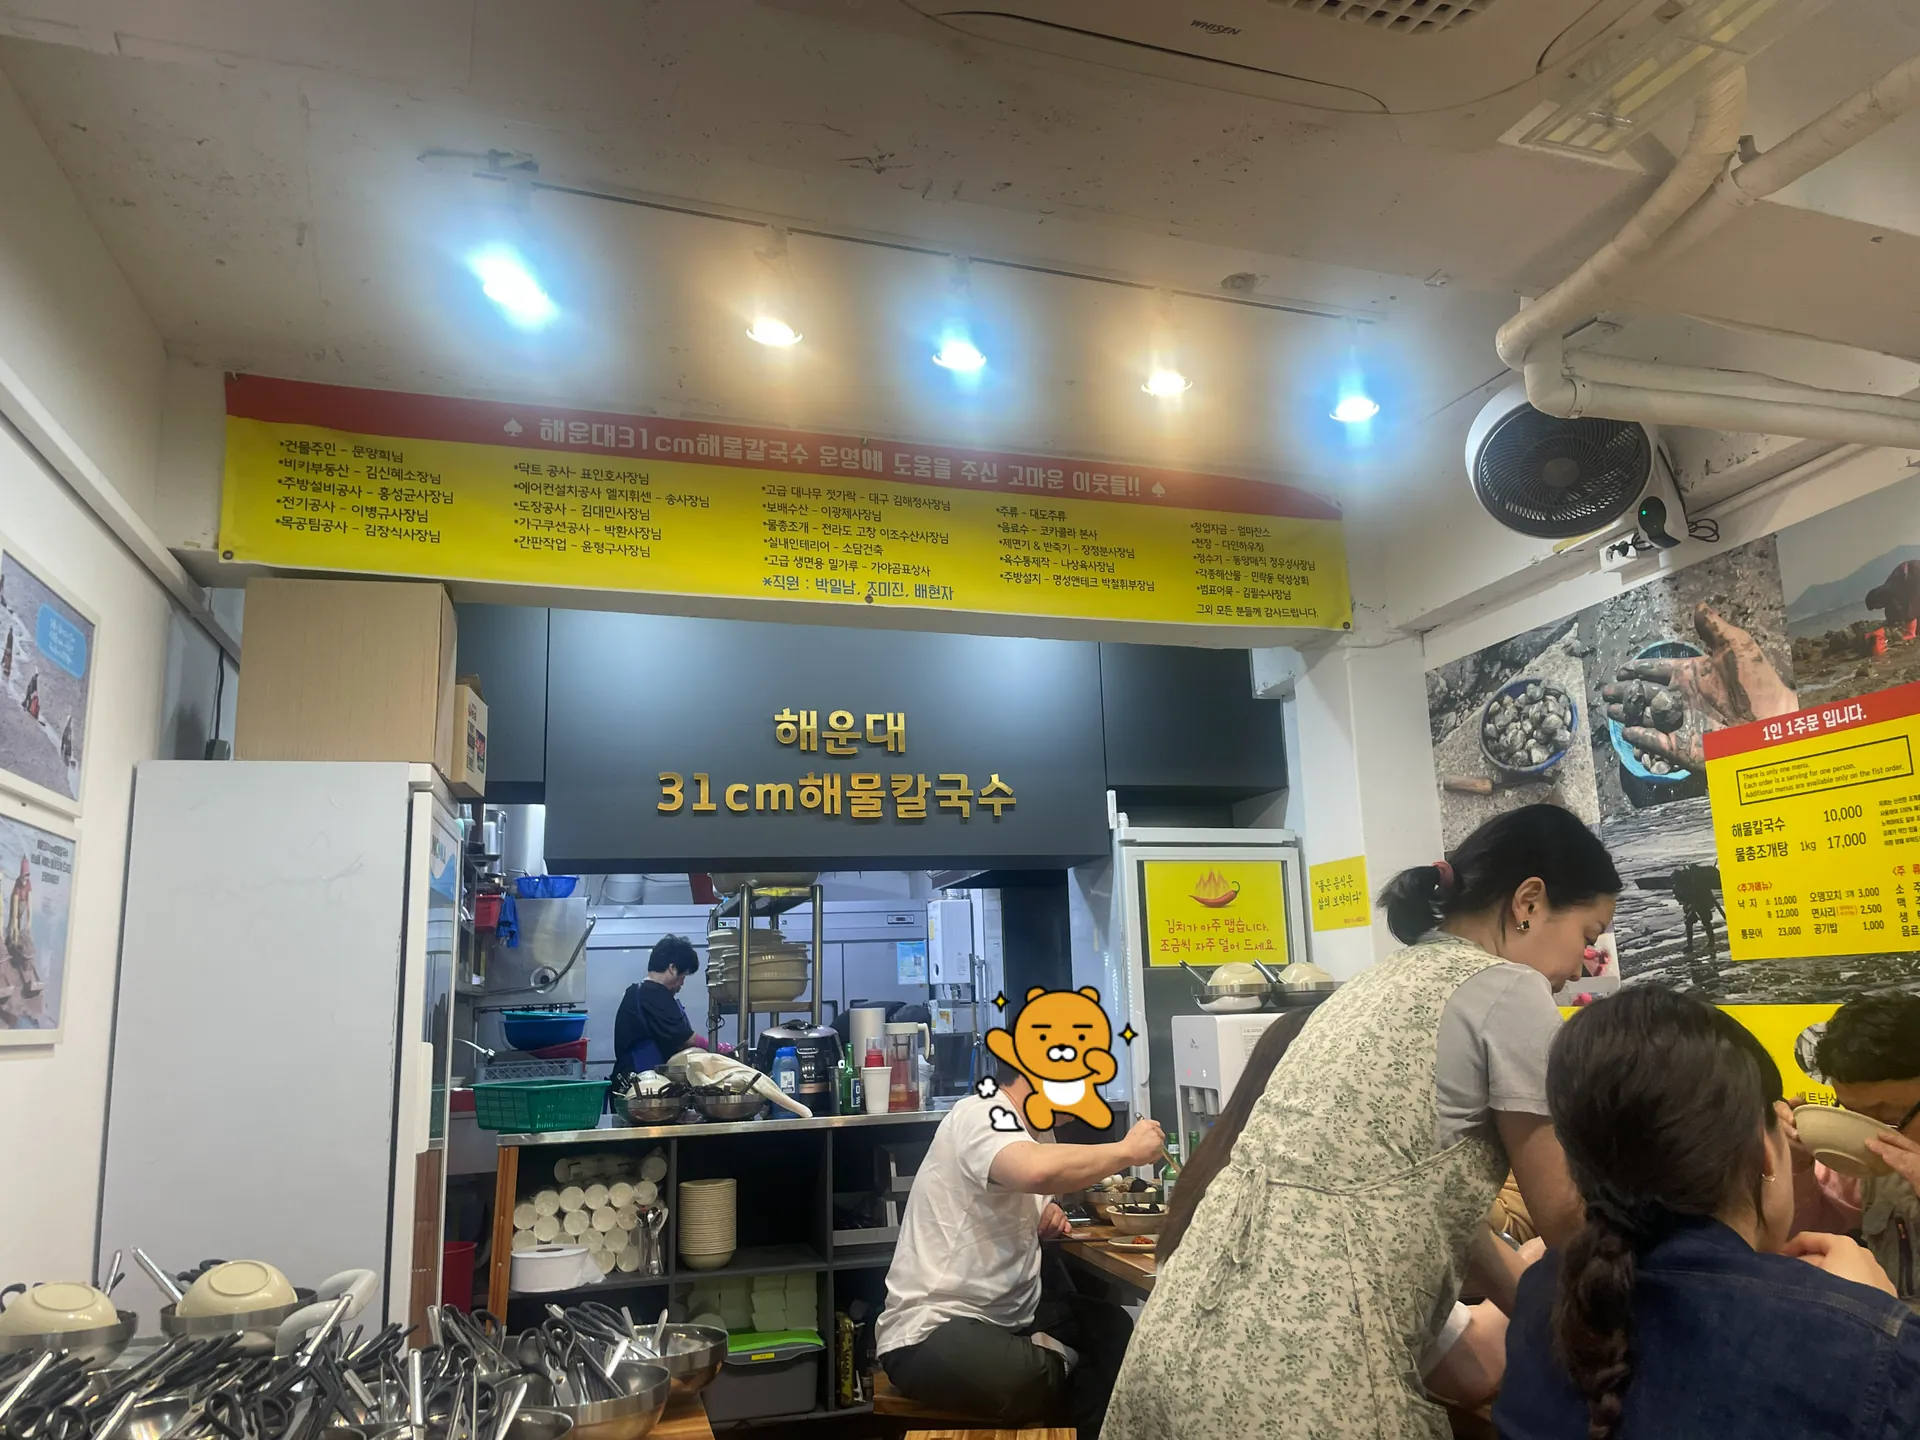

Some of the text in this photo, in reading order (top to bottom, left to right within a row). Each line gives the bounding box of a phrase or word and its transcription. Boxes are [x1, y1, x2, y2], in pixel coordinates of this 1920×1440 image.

[1190, 19, 1242, 35] WHISEN
[539, 417, 809, 465] 해운대31cm해물칼국수
[819, 445, 883, 473] 운영에
[893, 453, 951, 480] 도움을
[960, 459, 998, 484] 주신
[1007, 464, 1064, 491] 고마운
[284, 457, 350, 478] 비키부동산
[519, 462, 543, 476] 닥트
[581, 468, 650, 485] 표인호사장님
[282, 476, 363, 498] 주방설비공사
[519, 481, 710, 508] 에어컨설치공사 엘지휘센 송사장님
[765, 485, 787, 497] 고급
[791, 487, 822, 499] 대나무
[826, 489, 856, 503] 젓가락
[869, 493, 889, 506] 대구
[282, 496, 428, 523] 전기공사 이병규사장님
[519, 500, 650, 521] 도장공사 김대민사장님
[766, 502, 808, 516] 보배수산
[365, 523, 441, 544] 김장식사장님
[519, 517, 661, 541] 가구쿠션공사 박환사장님
[766, 520, 949, 545] 물총조개 전라도 고창 이조수산사장님
[1001, 522, 1098, 541] 음료수 코카콜라 본사
[519, 535, 567, 551] 간판작업
[767, 537, 884, 556] 실내인테리어 소담건축
[1002, 538, 1031, 551] 제면기
[1033, 541, 1040, 550] &
[1043, 542, 1071, 554] 반죽기
[768, 556, 790, 568] 고급
[793, 557, 824, 570] 생면용
[828, 559, 859, 572] 밀가루
[1003, 554, 1050, 568] 육수통제작
[1197, 554, 1222, 565] 정수기
[1233, 556, 1267, 567] 동양매직
[1003, 572, 1041, 584] 주방설치
[1198, 568, 1241, 582] 각종해산물
[914, 583, 954, 601] 배현자
[1216, 605, 1233, 616] 모든
[1763, 703, 1868, 741] 1인 1주문 입니다.
[774, 707, 906, 755] 해운대
[1743, 772, 1758, 780] There
[1786, 772, 1808, 781] serving
[1746, 788, 1773, 798] Additional
[1806, 777, 1833, 787] available
[1835, 774, 1848, 782] only
[657, 771, 1017, 819] 31cm해물칼국수
[1823, 805, 1863, 823] 10,000
[1731, 816, 1786, 838] 해물칼국수
[1735, 841, 1789, 862] 물총조개탕
[1800, 841, 1817, 852] 1kg
[1827, 832, 1867, 849] 17,000
[1333, 874, 1353, 890] 음식은
[1896, 884, 1904, 894] 소
[1774, 896, 1797, 906] 10,000
[1810, 890, 1842, 902] 오뎅꼬치
[1858, 887, 1879, 898] 3,000
[1776, 908, 1798, 918] 12,000
[1812, 907, 1836, 918] 면사리
[1860, 904, 1882, 914] 2,500
[1166, 917, 1269, 933] 김치가 아주 맵습니다.
[1778, 926, 1801, 936] 23,000
[1814, 920, 1884, 934] 공기밥 1,000
[1160, 938, 1277, 953] 조금씩 자주 덜어 드세요.
